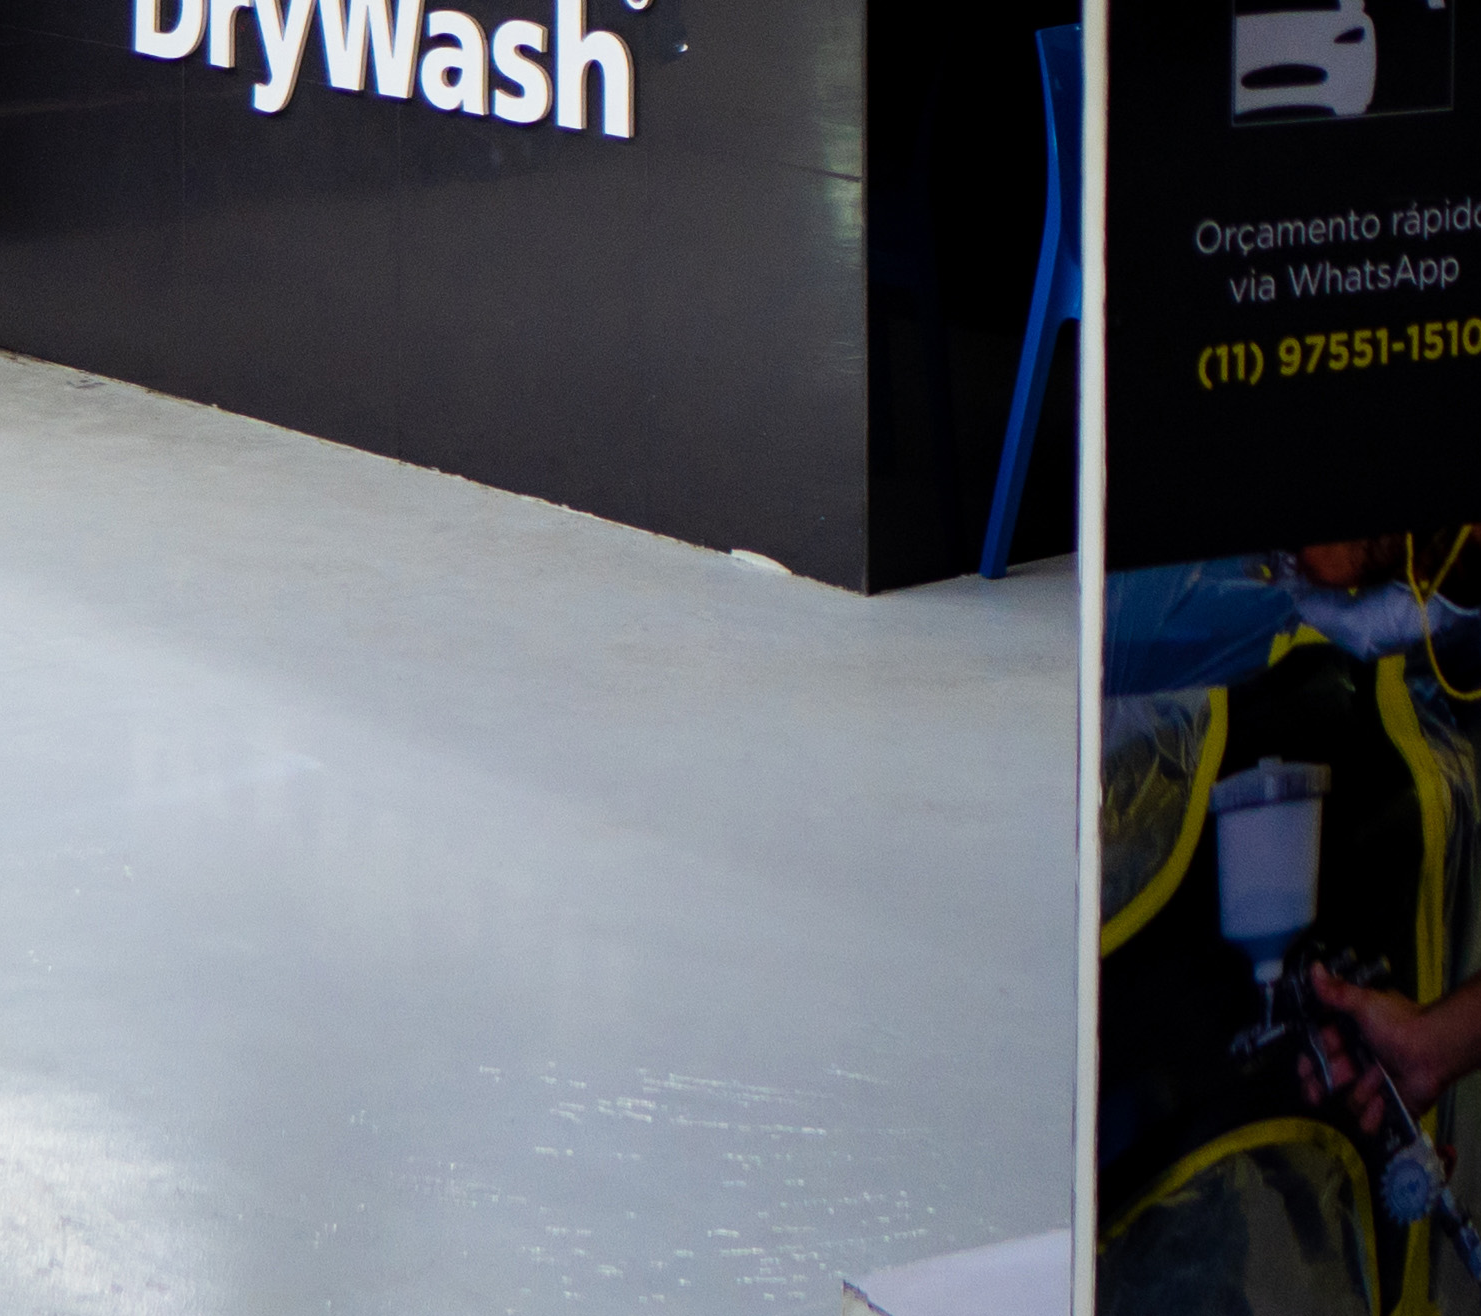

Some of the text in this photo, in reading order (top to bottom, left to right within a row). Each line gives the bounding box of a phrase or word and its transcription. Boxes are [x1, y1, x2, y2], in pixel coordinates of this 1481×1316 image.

[1195, 208, 1382, 256] Orçamento
[1229, 253, 1461, 303] via WhatsApp
[1197, 341, 1265, 391] (11)
